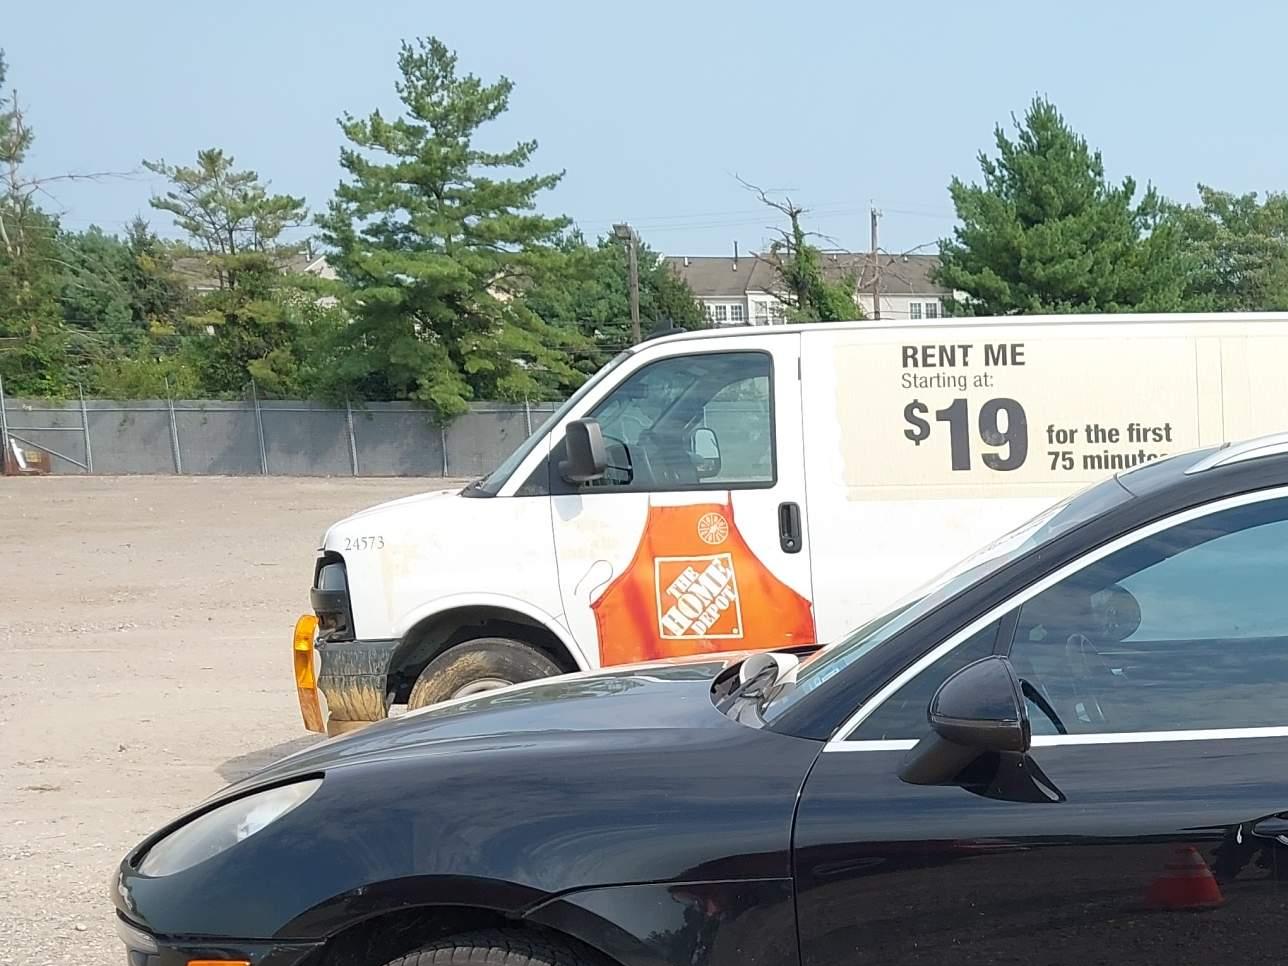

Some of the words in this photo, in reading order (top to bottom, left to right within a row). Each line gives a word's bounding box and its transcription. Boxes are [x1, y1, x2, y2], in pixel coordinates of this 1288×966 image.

[901, 344, 974, 369] RENT
[984, 342, 1026, 367] ME
[901, 371, 968, 391] Starting
[973, 373, 994, 389] at:
[903, 397, 1029, 472] $19
[1046, 423, 1078, 445] for
[1085, 423, 1120, 444] the
[1127, 422, 1173, 443] first
[1047, 450, 1075, 471] 75
[344, 535, 385, 551] 24573
[665, 565, 701, 599] THE
[661, 558, 733, 636] HOME
[690, 583, 737, 636] DEPOT
